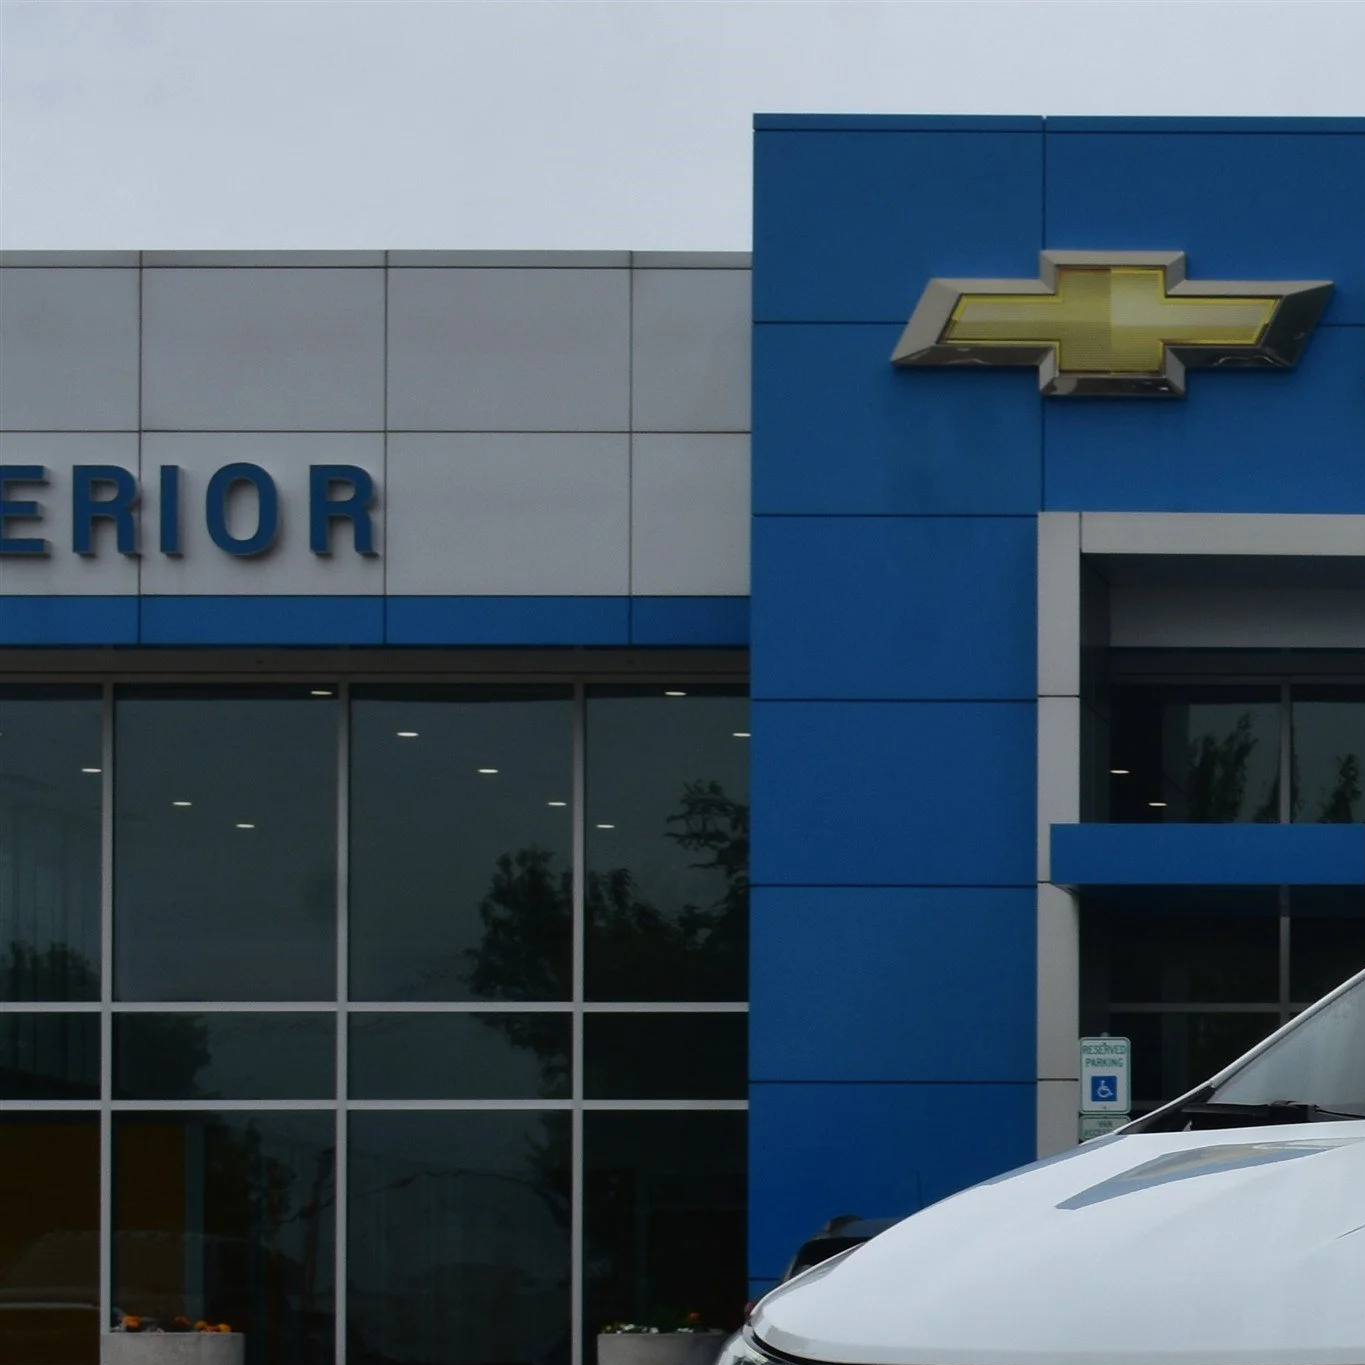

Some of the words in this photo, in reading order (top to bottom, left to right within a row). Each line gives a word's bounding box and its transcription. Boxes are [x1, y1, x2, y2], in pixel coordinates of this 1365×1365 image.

[0, 462, 377, 558] ERIOR
[1081, 1045, 1127, 1055] RESERVED
[1085, 1058, 1124, 1067] PARKING
